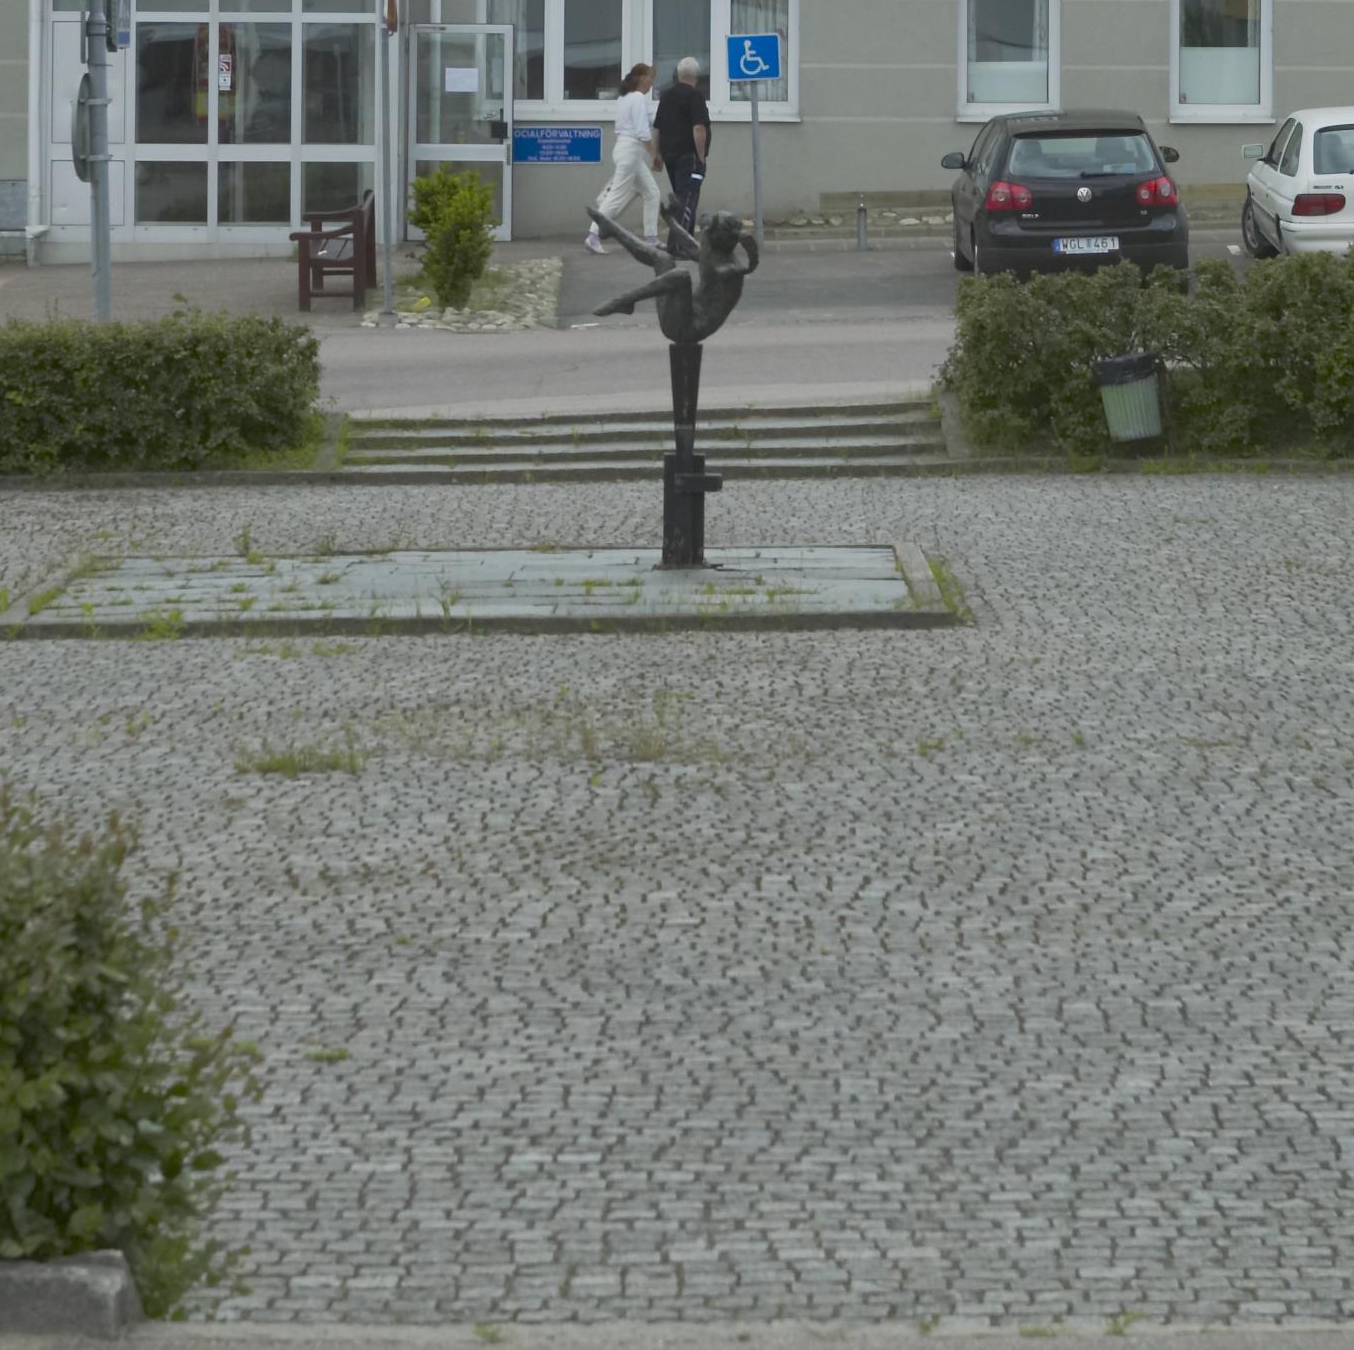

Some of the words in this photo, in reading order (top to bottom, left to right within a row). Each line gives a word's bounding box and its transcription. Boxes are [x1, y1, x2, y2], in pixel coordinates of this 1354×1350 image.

[514, 128, 601, 139] OCIALFÖRVALTNING
[1061, 238, 1084, 250] WGL
[1094, 237, 1115, 249] 461
